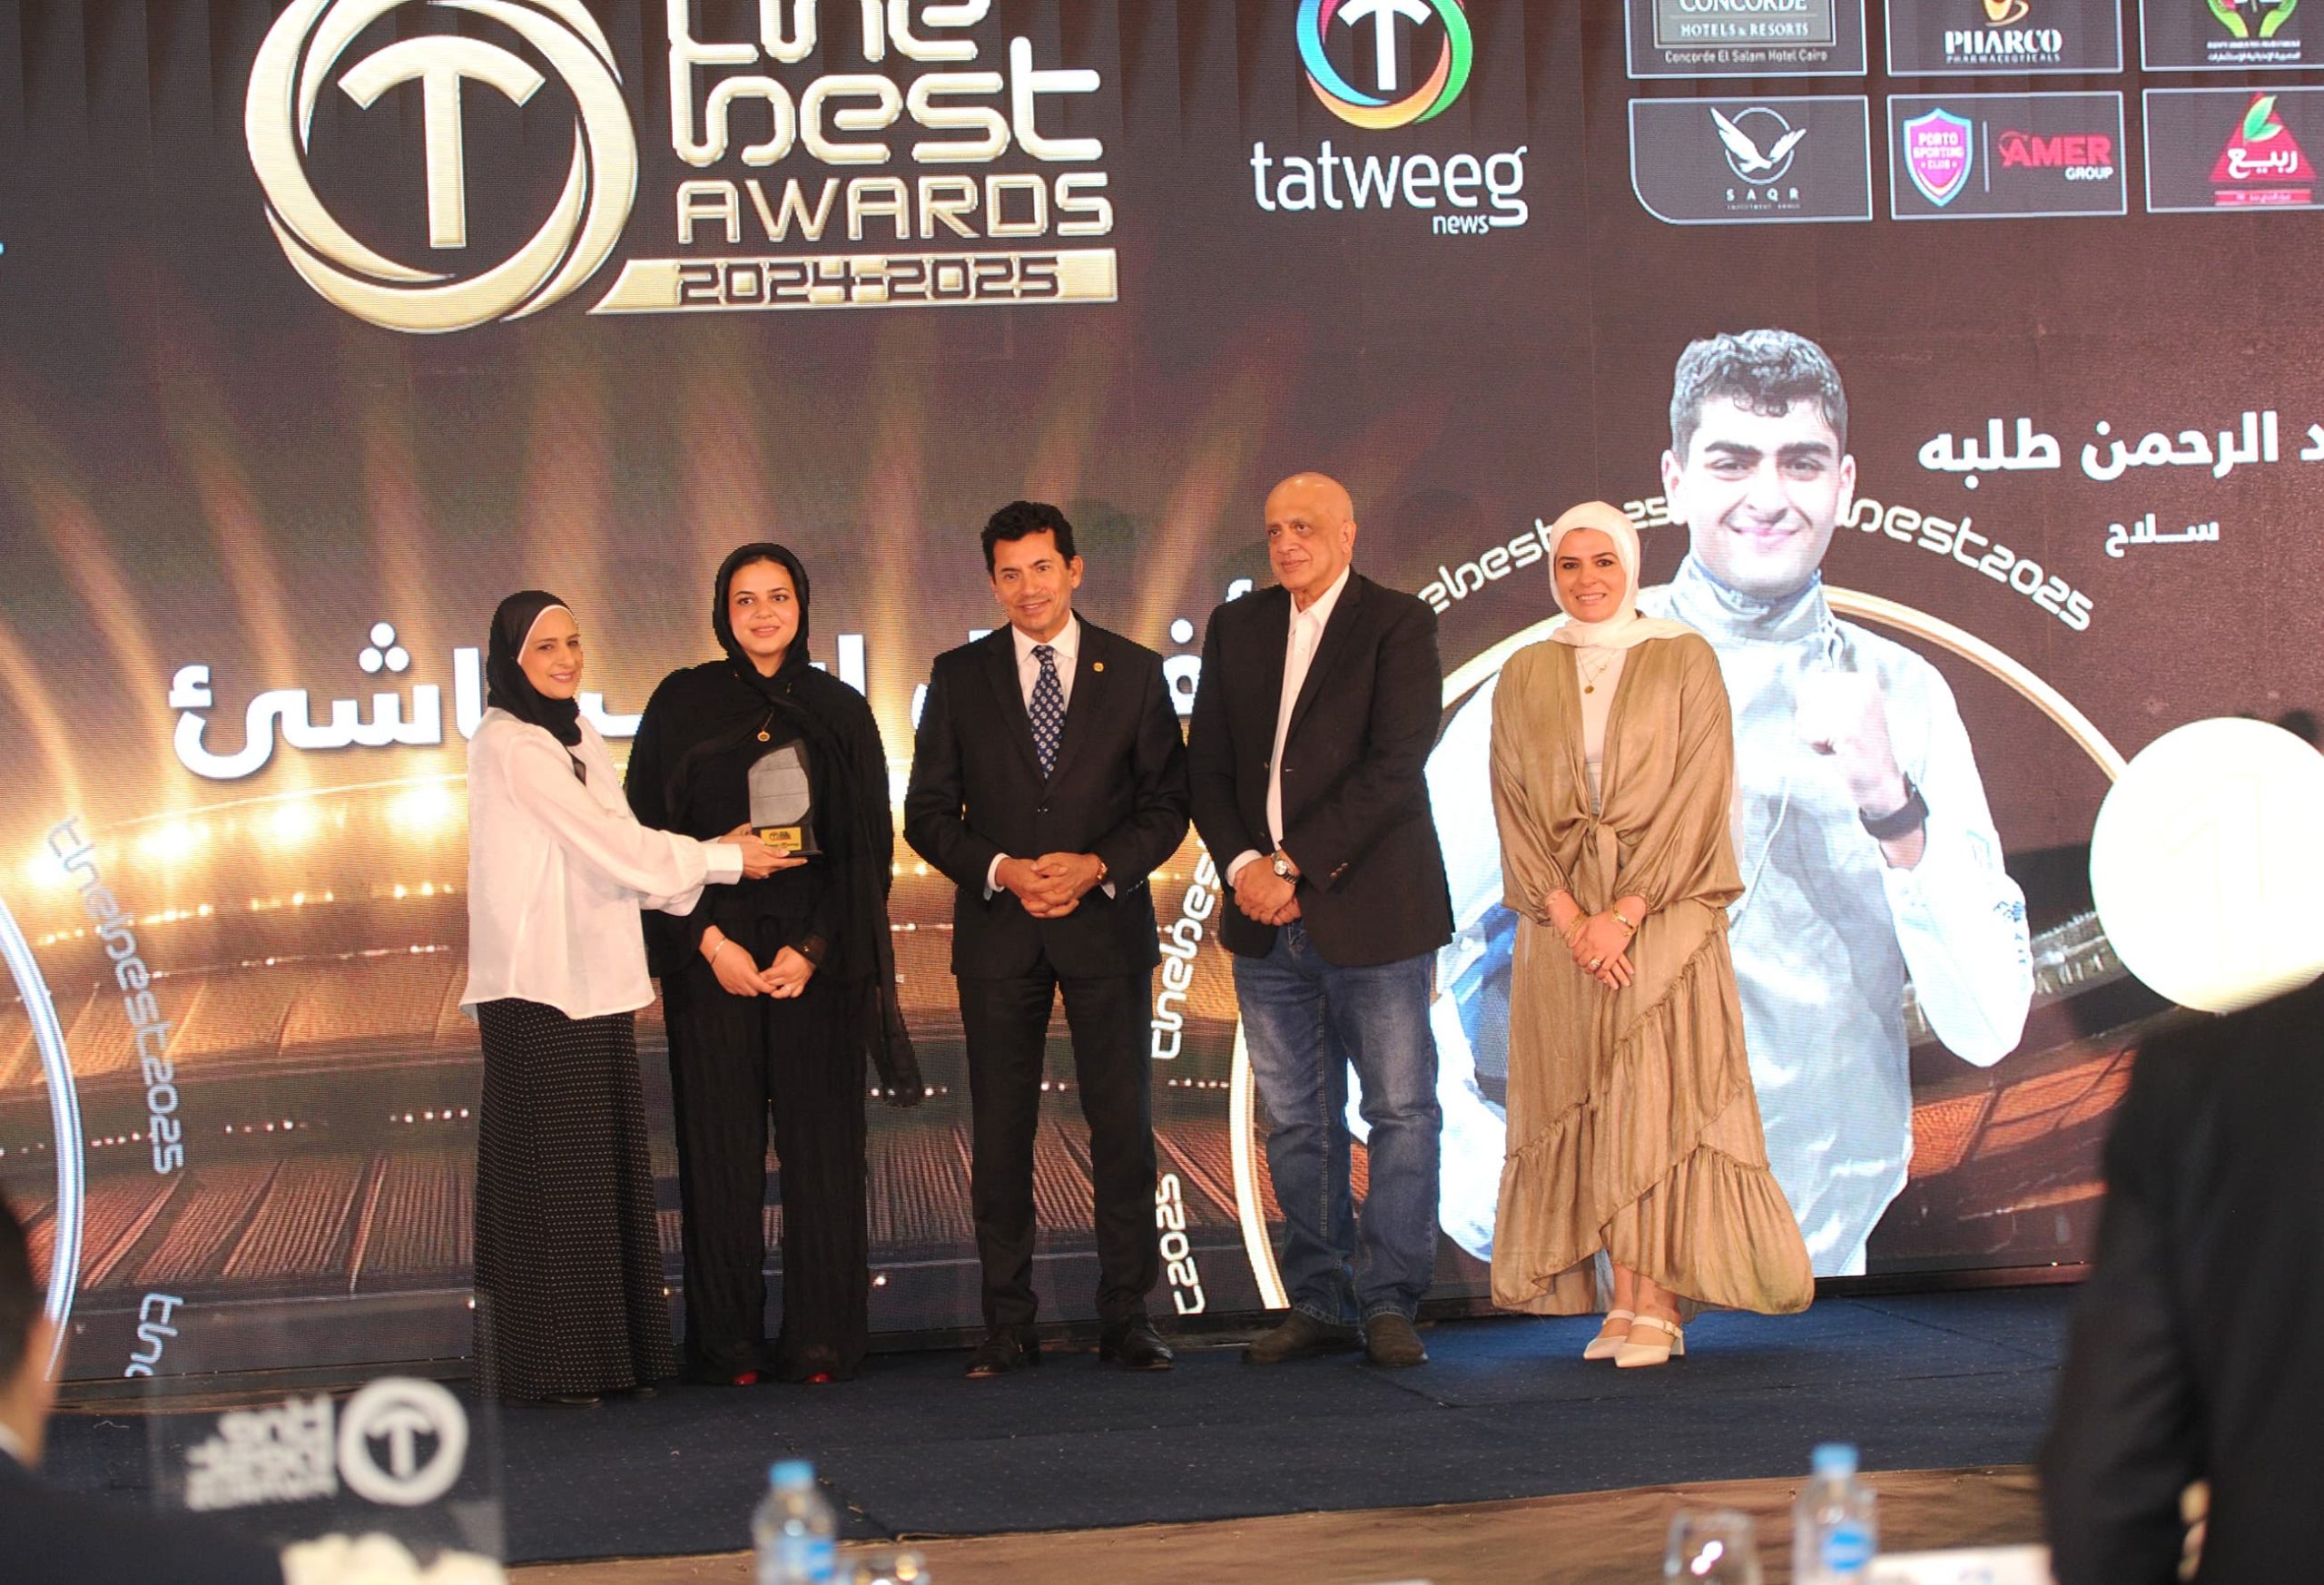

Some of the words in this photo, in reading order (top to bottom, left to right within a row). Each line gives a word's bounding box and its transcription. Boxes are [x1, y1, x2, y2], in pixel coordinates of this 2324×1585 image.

[1680, 24, 1736, 36] HOTELS
[1749, 23, 1808, 36] RESORTS
[1945, 29, 2063, 54] PHARCO
[1665, 50, 1716, 64] Concorde
[1731, 50, 1767, 63] Salam
[1769, 49, 1797, 62] Hotel
[1798, 48, 1828, 62] Cairo
[670, 36, 1103, 166] best
[1918, 132, 1958, 146] PORTO
[2000, 132, 2112, 167] AMER
[2065, 166, 2114, 181] GROUP
[2227, 147, 2298, 180] ربيع
[1250, 140, 1529, 228] tatweeg
[676, 172, 1113, 244] AWARDS
[1433, 214, 1490, 235] news
[678, 255, 1060, 305] 2024-2025
[2081, 410, 2280, 481] الرحمن
